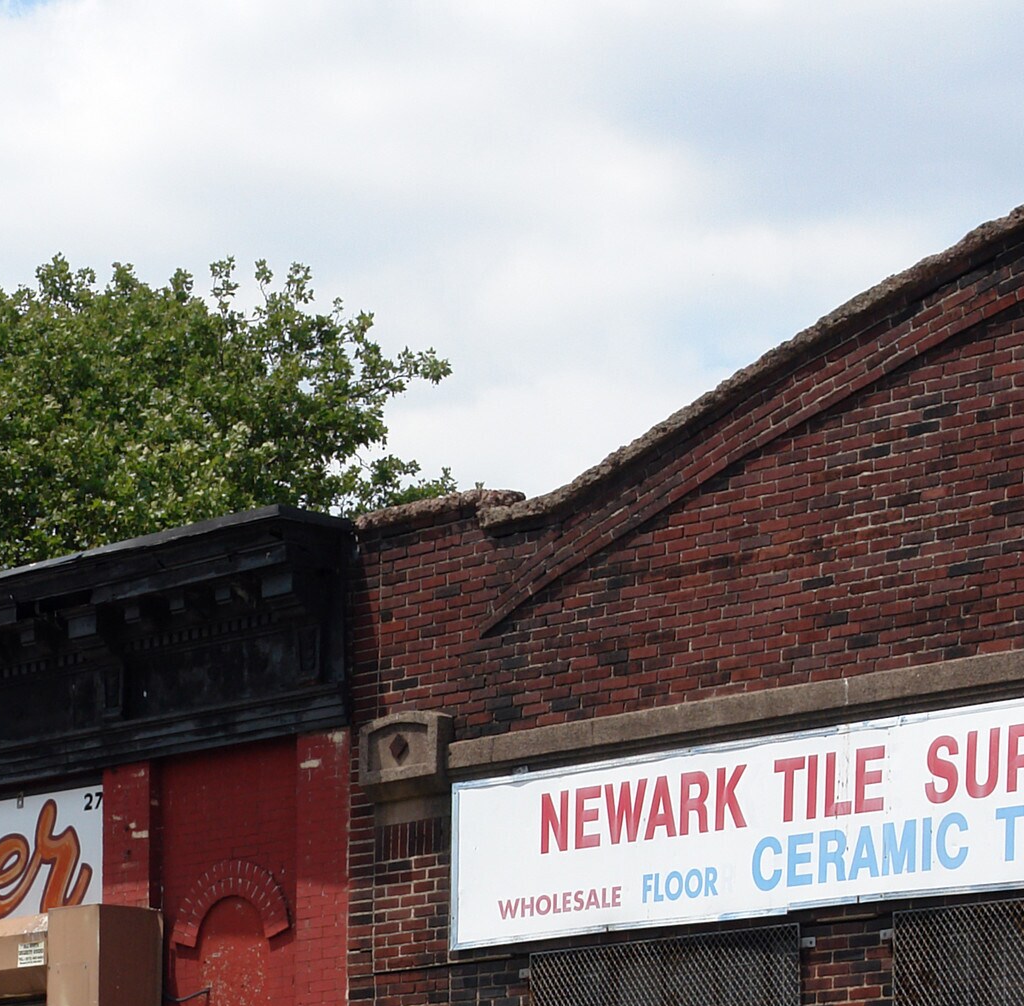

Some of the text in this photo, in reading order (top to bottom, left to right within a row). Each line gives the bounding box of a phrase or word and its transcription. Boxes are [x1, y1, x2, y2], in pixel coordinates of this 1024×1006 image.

[83, 791, 103, 811] 27
[540, 764, 748, 854] NEWARK
[774, 745, 886, 823] TILE
[497, 886, 622, 920] WHOLESALE
[641, 867, 718, 904] FLOOR
[752, 812, 969, 891] CERAMIC
